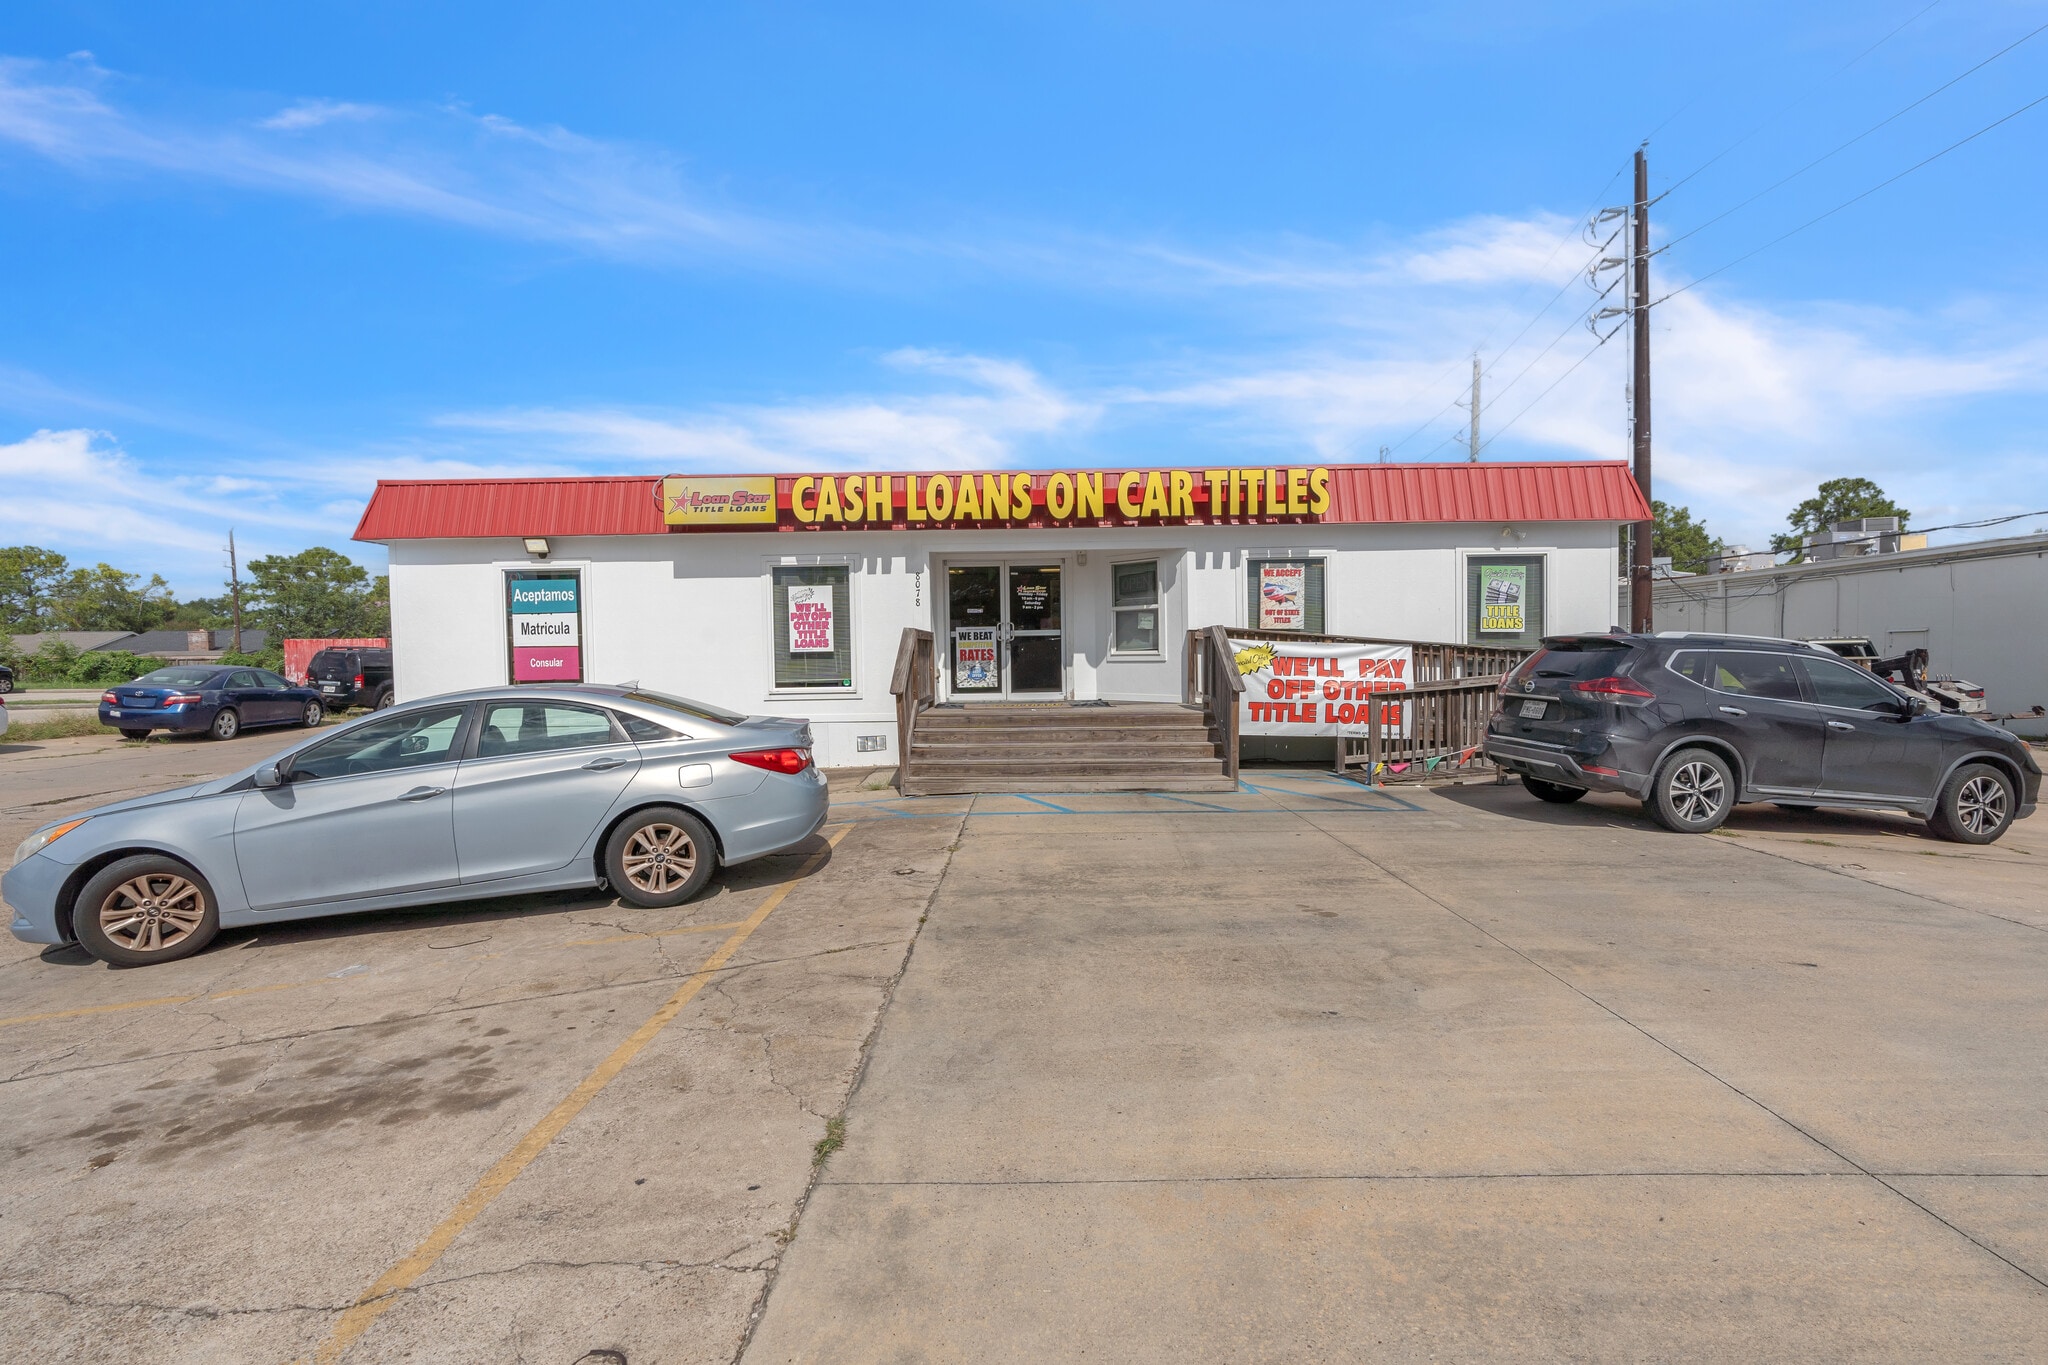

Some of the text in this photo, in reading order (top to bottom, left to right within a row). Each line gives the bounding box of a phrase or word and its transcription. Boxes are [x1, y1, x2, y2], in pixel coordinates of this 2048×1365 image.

[690, 490, 770, 506] Loan Star
[791, 467, 1330, 523] CASH LOANS ON CAR TITLES
[1263, 568, 1302, 577] WE ACCEPT
[513, 588, 575, 605] Aceptamos
[795, 603, 827, 612] WE'LL
[1486, 605, 1520, 617] TITLE
[790, 611, 832, 621] PAY OFF
[521, 621, 571, 636] Matricula
[793, 621, 830, 630] OTHER
[1482, 617, 1524, 629] LOANS
[797, 630, 827, 639] TITLE
[958, 631, 993, 640] WE BEAT
[794, 638, 829, 648] LOANS
[959, 648, 995, 662] RATES
[1236, 655, 1252, 667] pecial
[530, 658, 564, 667] Consular
[1271, 656, 1407, 679] WE'LL PAY
[1267, 678, 1316, 700] OFF
[1248, 702, 1317, 723] TITLE
